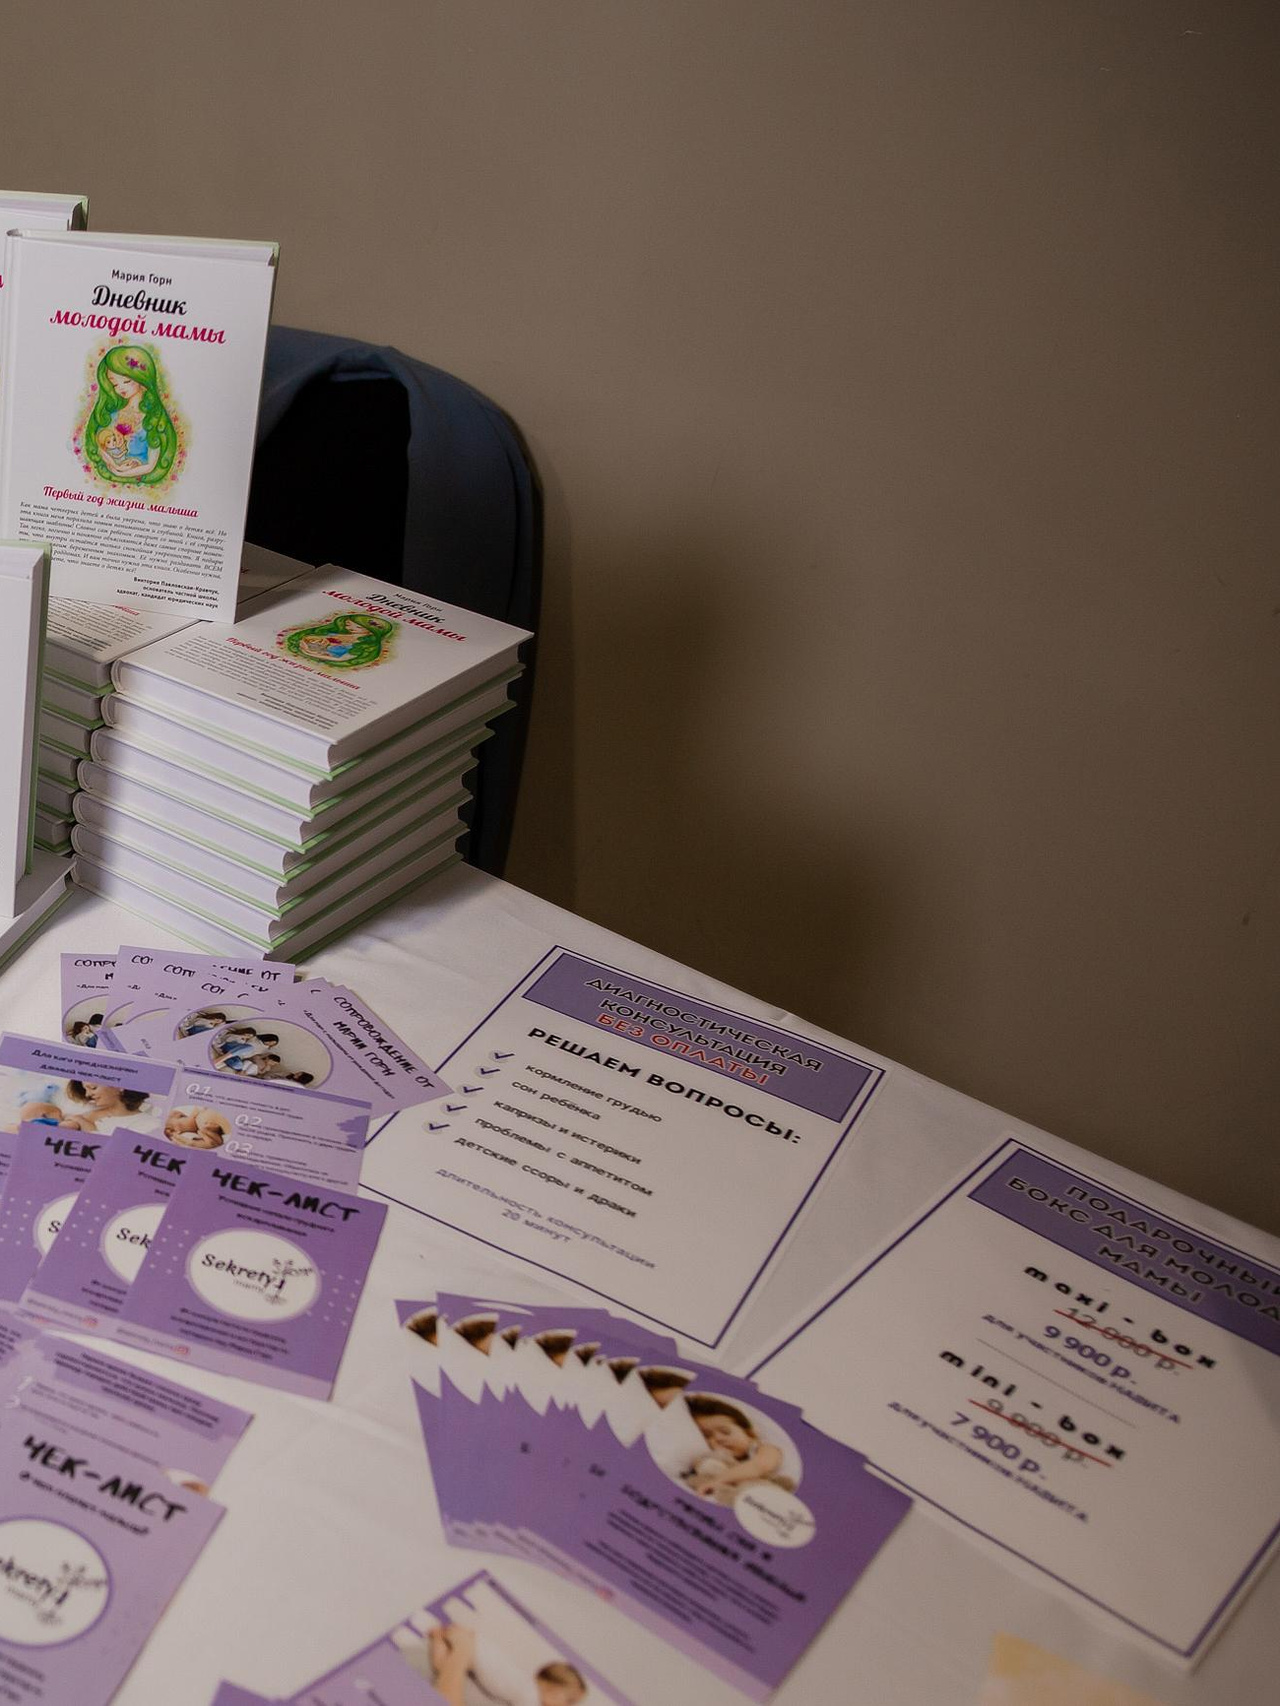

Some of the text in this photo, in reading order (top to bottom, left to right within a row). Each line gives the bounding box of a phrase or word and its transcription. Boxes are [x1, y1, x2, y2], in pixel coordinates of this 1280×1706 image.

[91, 284, 187, 316] Дневник
[111, 269, 172, 286] Мария Горн
[49, 309, 227, 345] молодой мамы
[43, 486, 199, 518] Первый год жизни малыша
[322, 589, 467, 642] молодой мамы
[366, 592, 446, 624] Дневник
[333, 1021, 396, 1076] МАРИИ ГОРН
[334, 996, 418, 1074] СОПРОВОЖДЕНИЕ
[415, 1075, 436, 1088] ОТ
[585, 977, 823, 1072] ДИАГНОСТИЧЕСКАЯ
[595, 1012, 770, 1086] БЕЗ ОПЛАТЫ
[599, 999, 788, 1077] КОНСУЛЬТАЦИЯ
[512, 1080, 538, 1095] сон
[525, 1064, 663, 1123] кормление грудью
[528, 1027, 803, 1145] РЕШАЕМ ВОПРОСЫ:
[475, 1118, 653, 1197] проблемы с аппетитом
[493, 1100, 642, 1165] капризы и истерики
[212, 1168, 360, 1221] ЧЕК-ЛИСТ
[453, 1137, 638, 1219] детские ссоры и драки
[1007, 1177, 1280, 1322] БОКС ДЛЯ МОЛОД
[1098, 1246, 1203, 1302] МАМЫ
[1043, 1325, 1061, 1339] 9
[1064, 1336, 1112, 1367] 900
[950, 1411, 970, 1426] 7
[972, 1425, 1021, 1461] 900
[23, 1435, 188, 1522] ЧЕК-ЛИСТ
